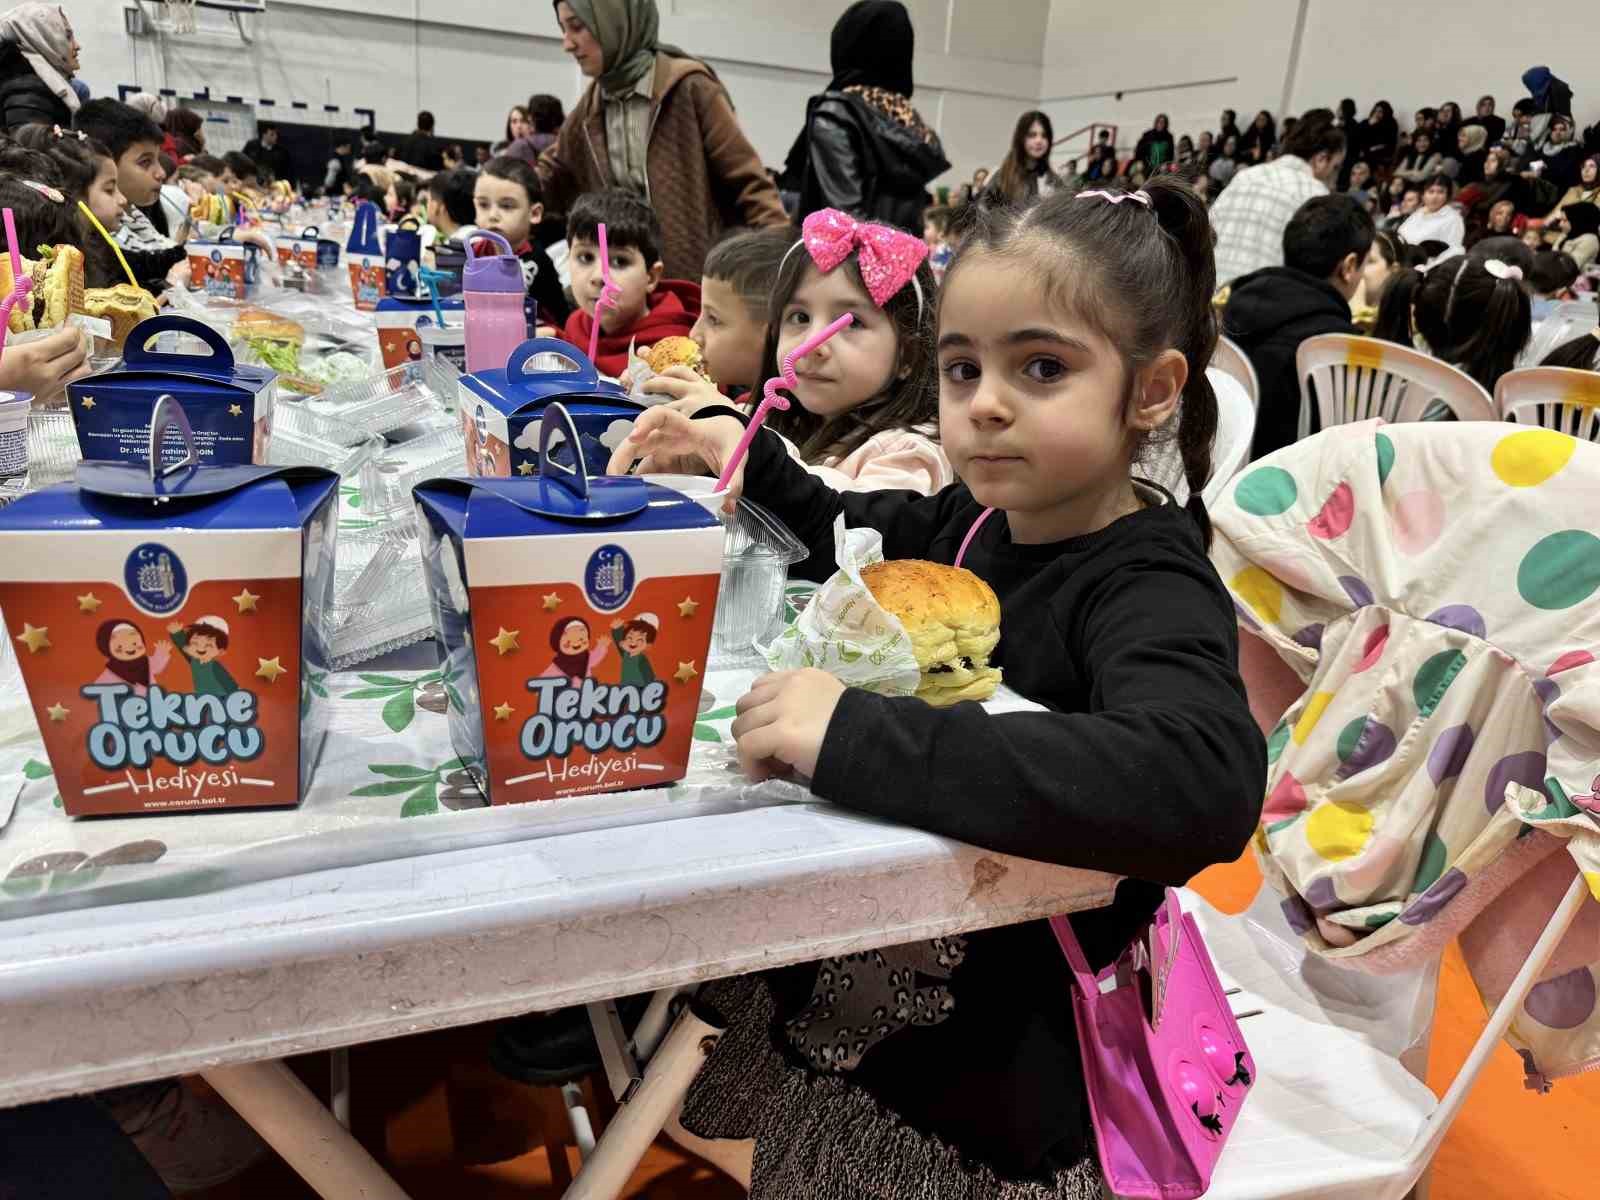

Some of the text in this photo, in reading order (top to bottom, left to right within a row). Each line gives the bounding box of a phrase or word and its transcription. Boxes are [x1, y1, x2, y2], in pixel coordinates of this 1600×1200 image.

[81, 683, 256, 730] Tekne
[527, 677, 665, 720] Tekne
[88, 722, 263, 767] Orucu
[520, 713, 664, 757] Orucu
[125, 765, 239, 798] Hediyesi
[545, 751, 638, 784] Hediyesi
